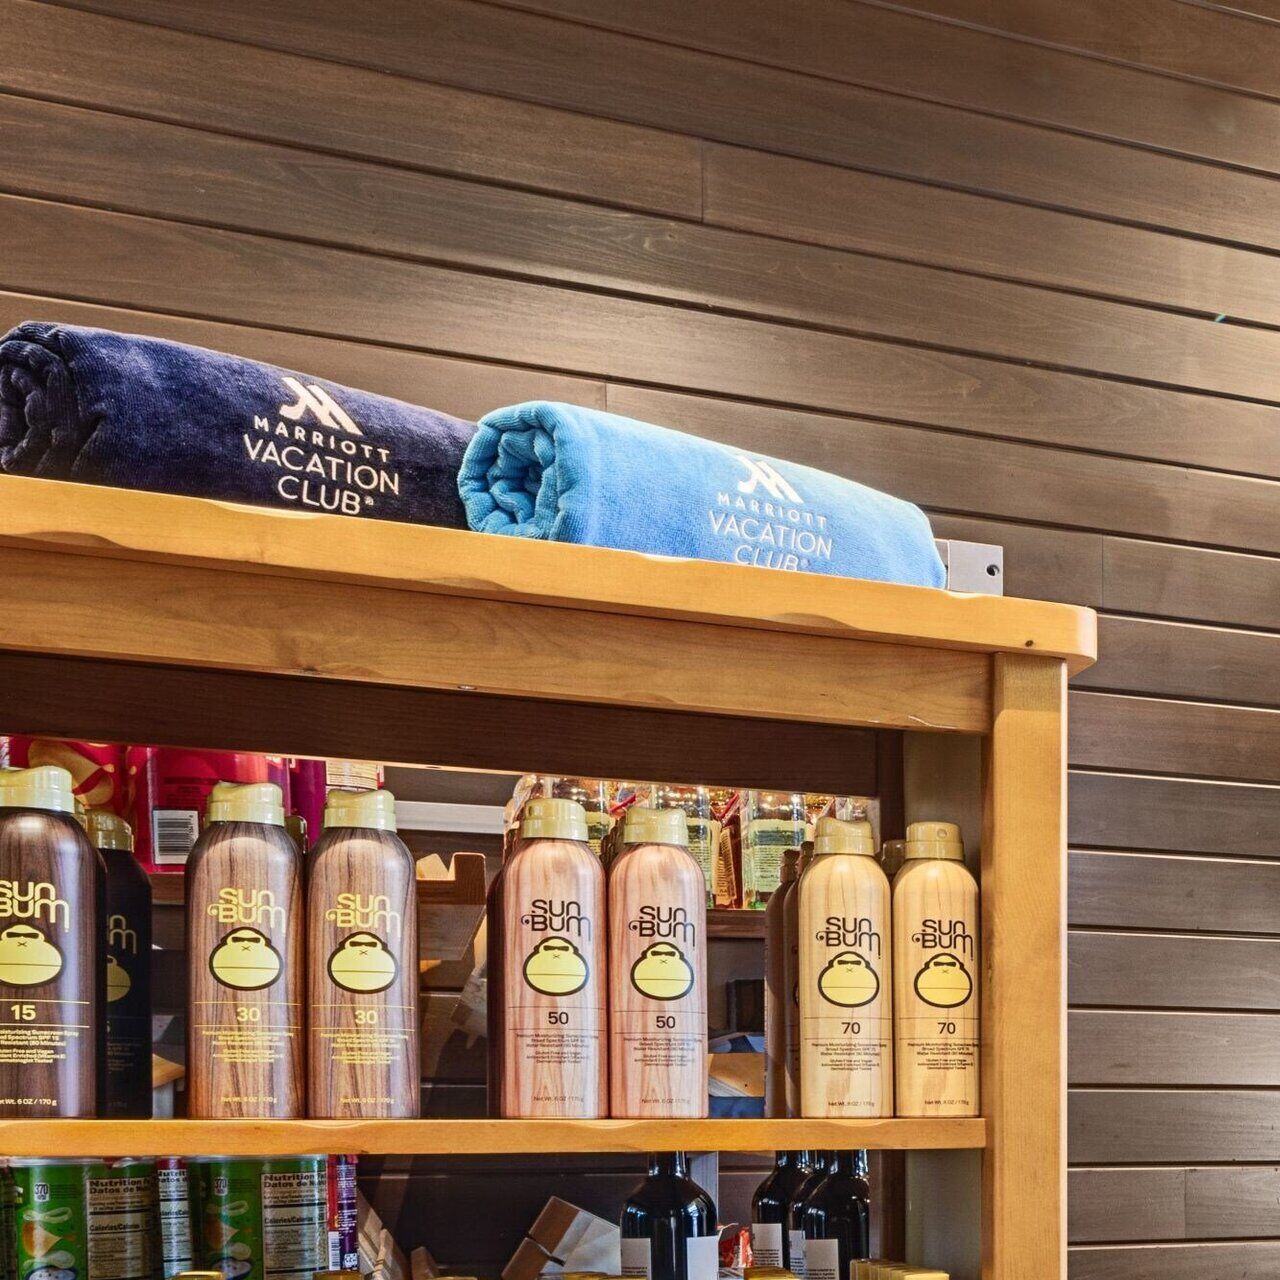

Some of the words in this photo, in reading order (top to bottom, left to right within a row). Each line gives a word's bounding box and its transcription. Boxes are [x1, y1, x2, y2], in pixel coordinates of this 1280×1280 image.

[253, 415, 390, 464] MARRIOTT
[243, 433, 399, 495] VACATION
[717, 491, 827, 530] MARRIOTT
[708, 509, 832, 560] VACATION
[10, 1004, 36, 1021] 15
[548, 1011, 569, 1025] 50
[841, 1022, 861, 1035] 70
[937, 1022, 956, 1035] 70
